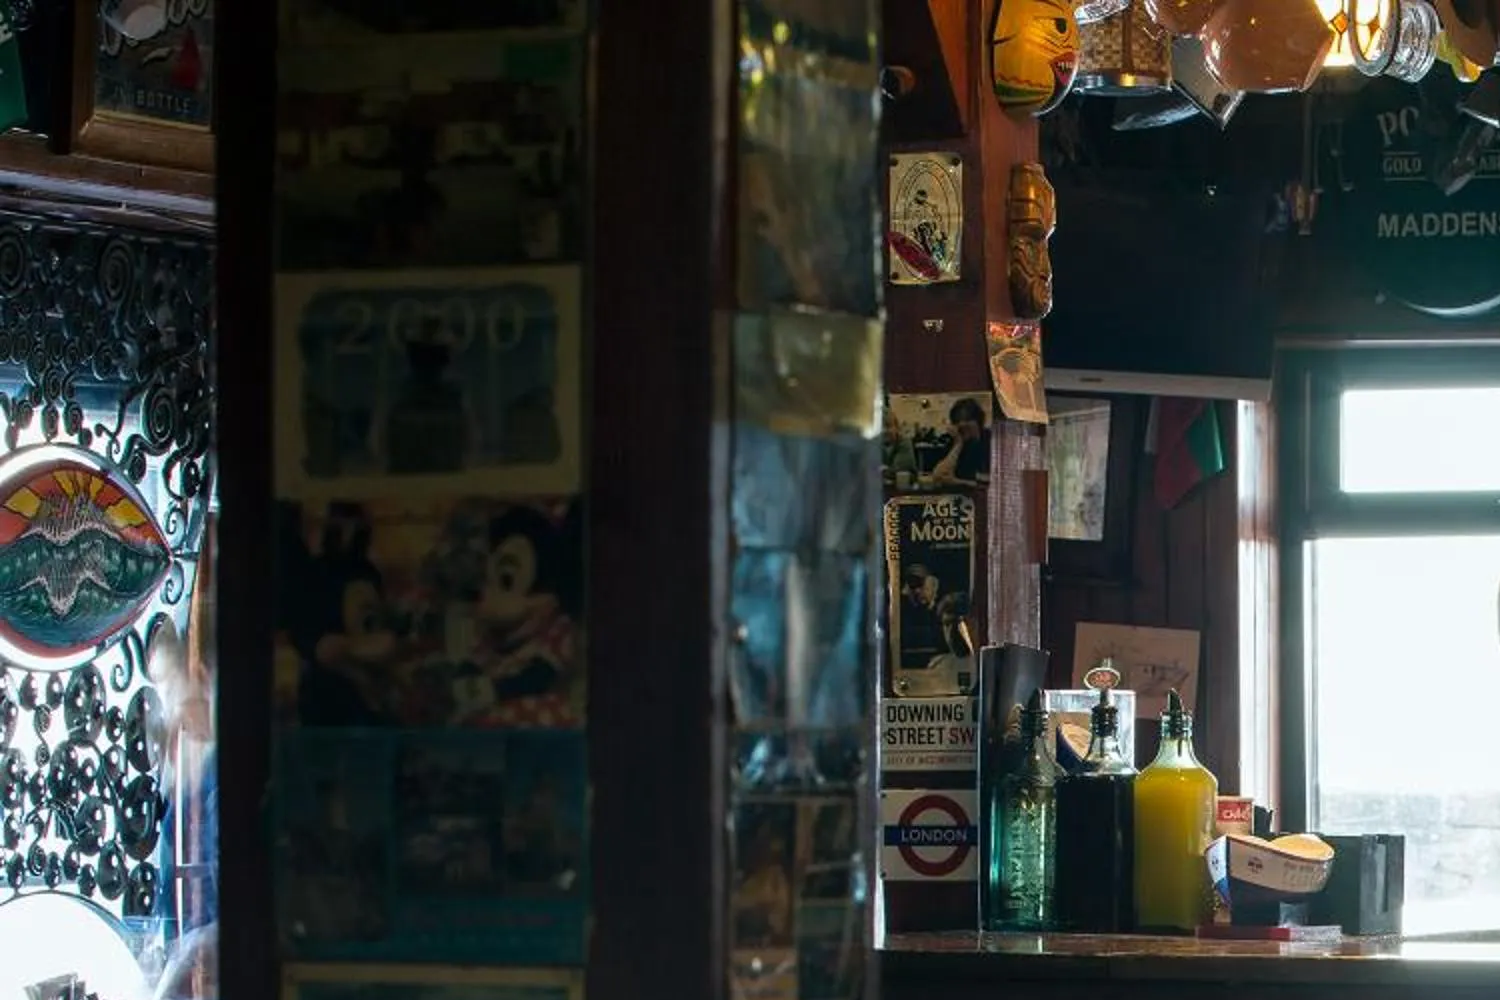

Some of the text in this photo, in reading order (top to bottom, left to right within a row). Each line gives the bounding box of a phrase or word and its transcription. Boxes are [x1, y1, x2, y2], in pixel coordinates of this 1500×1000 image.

[1382, 156, 1423, 174] GOLD
[886, 704, 964, 723] DOWNING
[886, 726, 945, 746] STREET
[901, 828, 967, 843] LONDON
